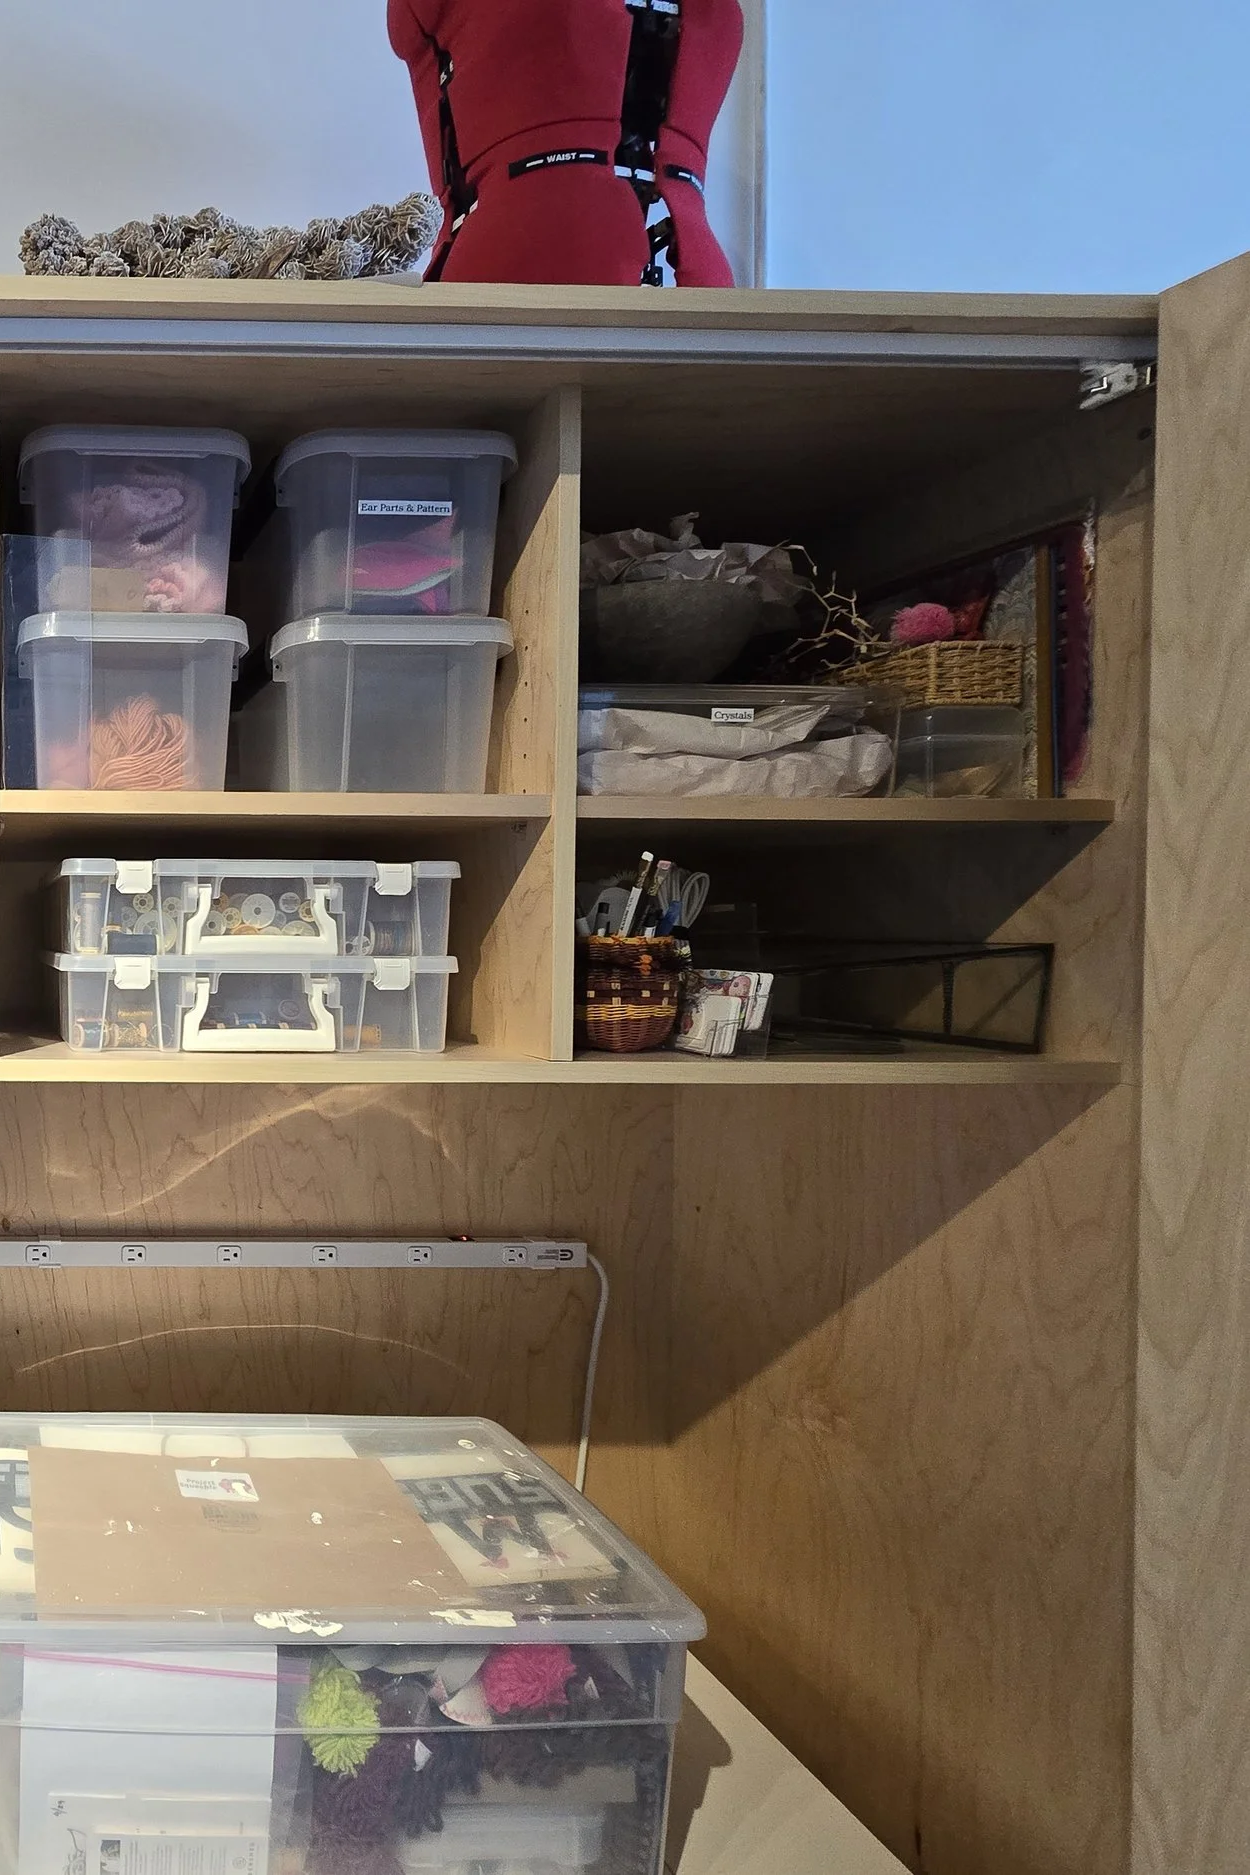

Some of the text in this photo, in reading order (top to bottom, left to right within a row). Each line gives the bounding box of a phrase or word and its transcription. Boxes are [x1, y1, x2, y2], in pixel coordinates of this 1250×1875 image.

[546, 152, 577, 164] WAIST
[361, 503, 450, 513] Ear Parts & Pattern
[714, 711, 752, 721] Crystals
